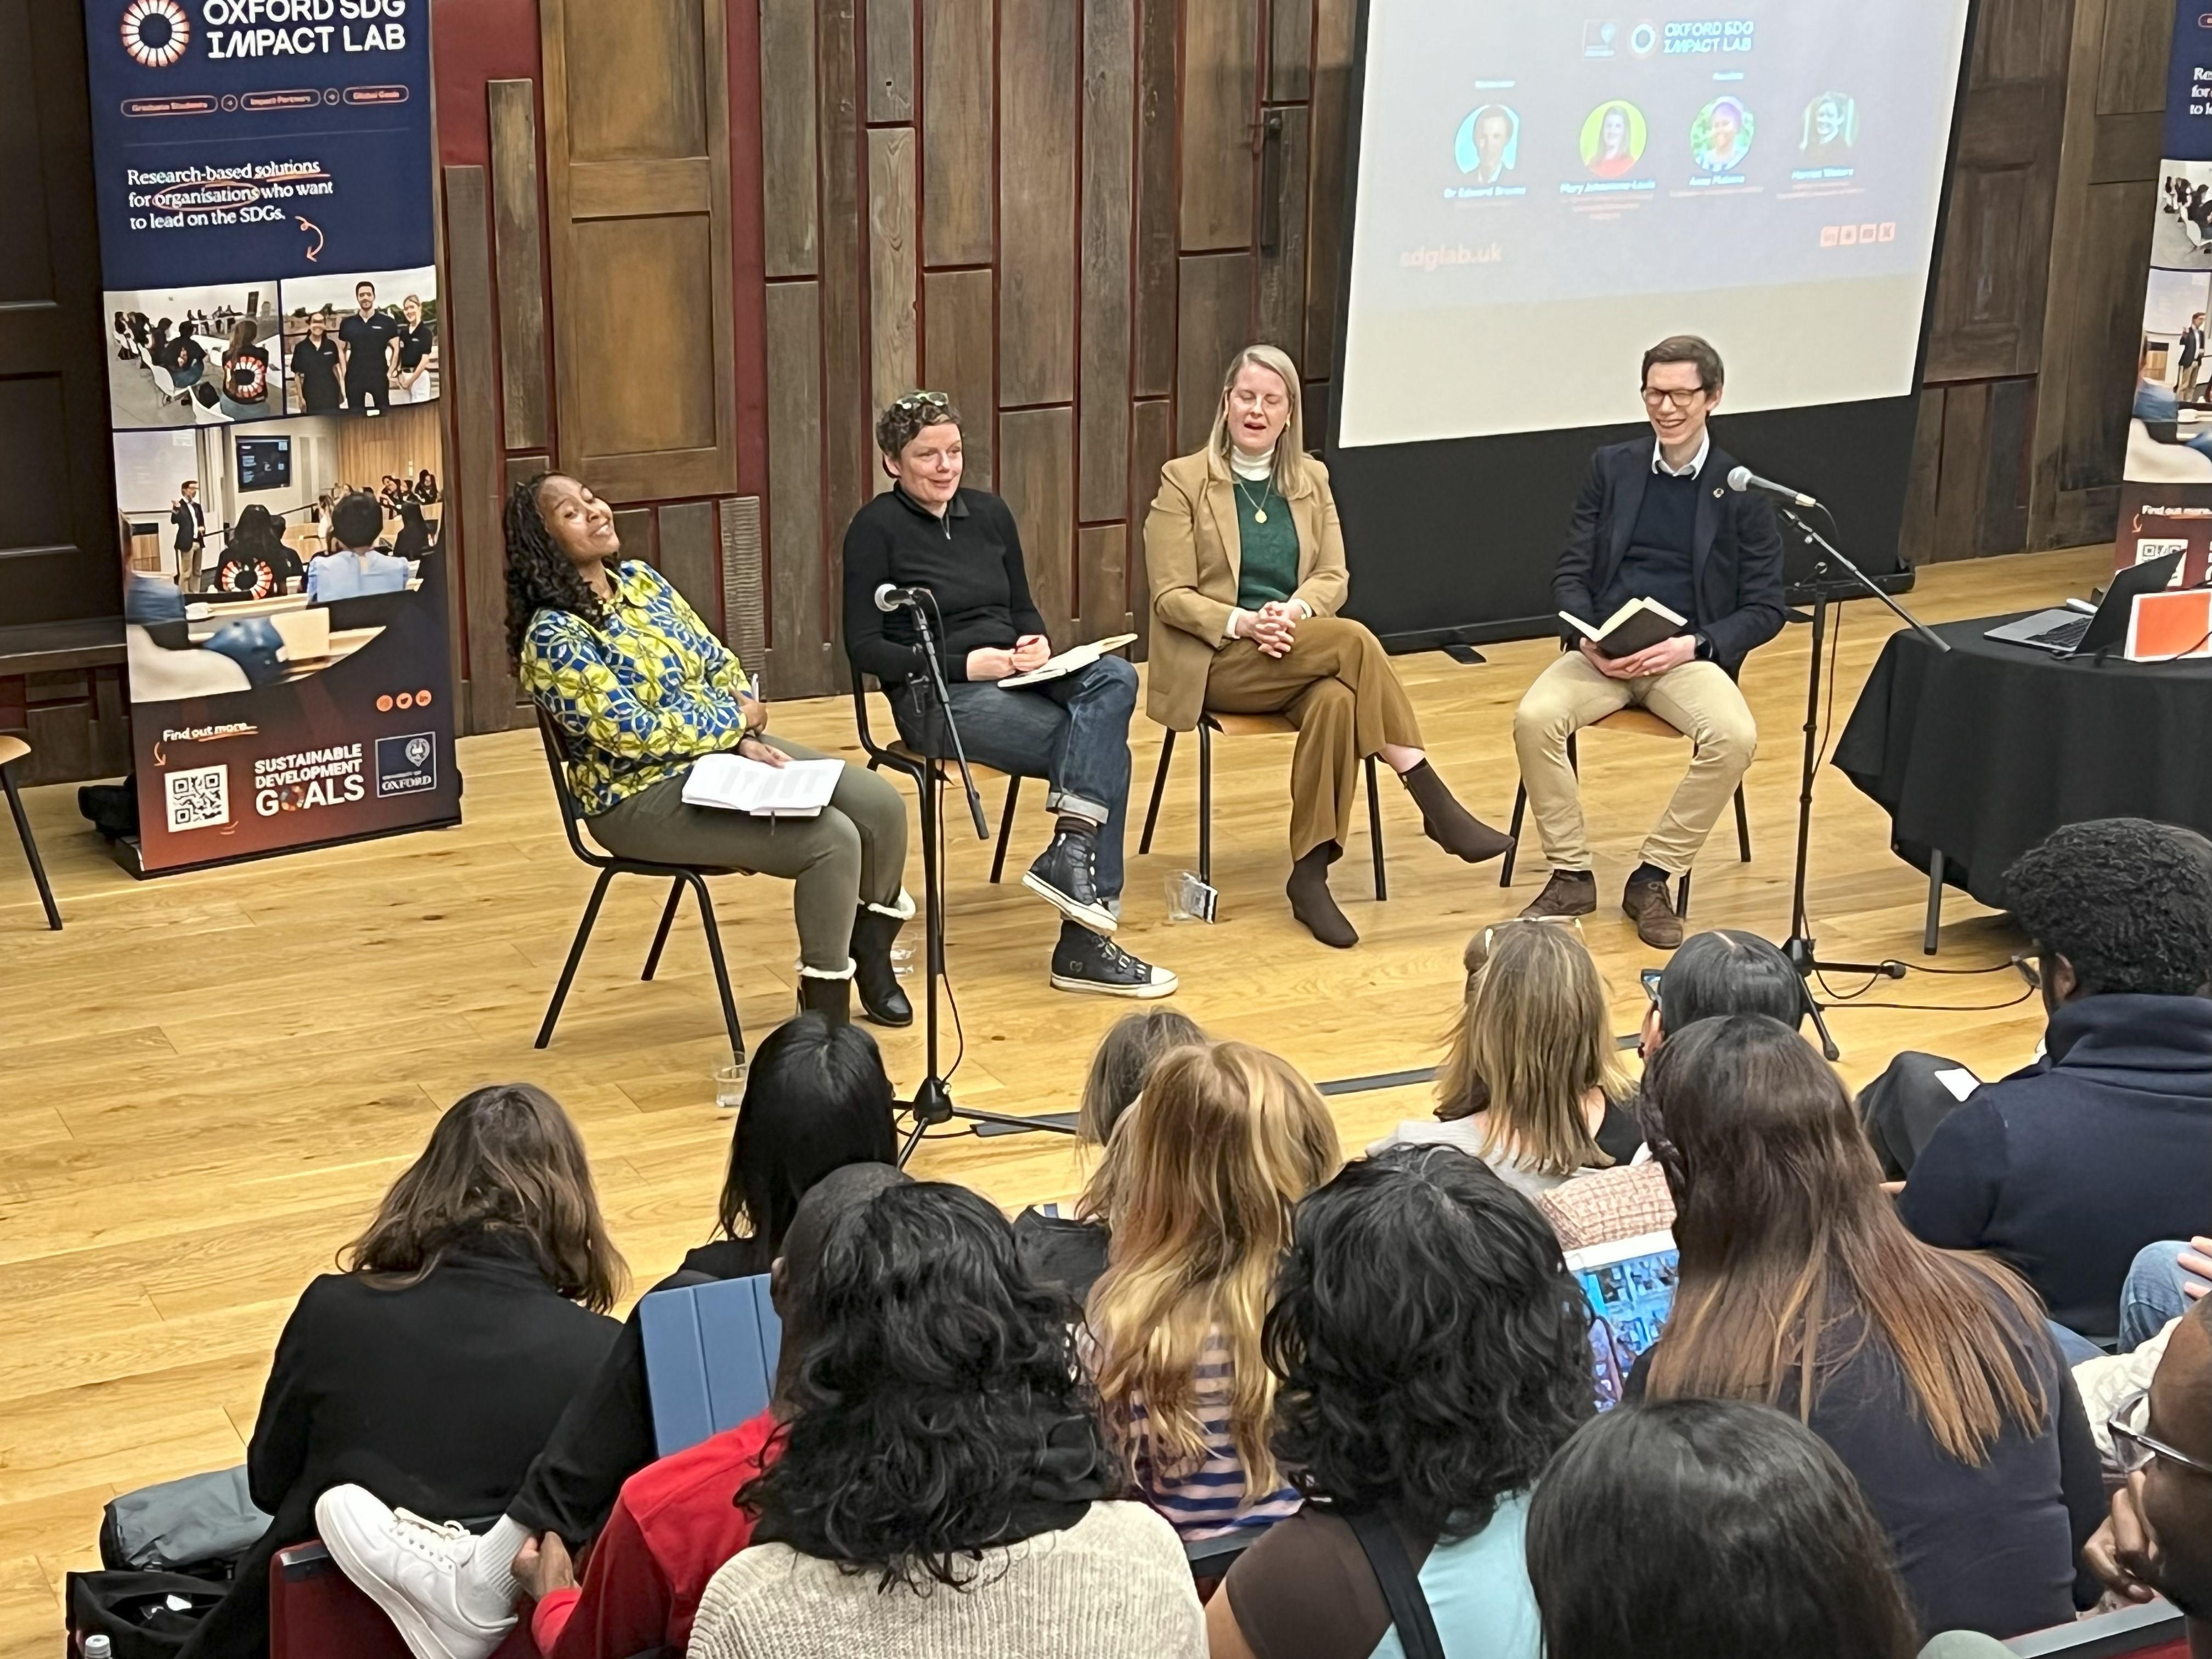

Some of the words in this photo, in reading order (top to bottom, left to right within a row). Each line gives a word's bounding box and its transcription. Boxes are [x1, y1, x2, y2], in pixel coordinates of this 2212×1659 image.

[203, 0, 334, 25] OXFORD
[340, 0, 405, 19] SDG
[206, 26, 335, 59] IMPACT
[343, 24, 406, 52] LAB
[127, 163, 252, 185] Research-based
[255, 159, 321, 179] solutions
[128, 191, 151, 208] for
[155, 186, 260, 209] organisations
[261, 183, 294, 199] who
[295, 181, 334, 196] want
[129, 218, 148, 230] to
[149, 211, 184, 229] lead
[187, 212, 208, 226] on
[211, 209, 236, 225] the
[240, 205, 286, 223] SDGs.
[163, 727, 191, 742] Find
[191, 726, 213, 738] out
[255, 743, 362, 774] SUSTAINABLE
[255, 759, 363, 789] DEVELOPMENT
[382, 775, 432, 791] OXFORD
